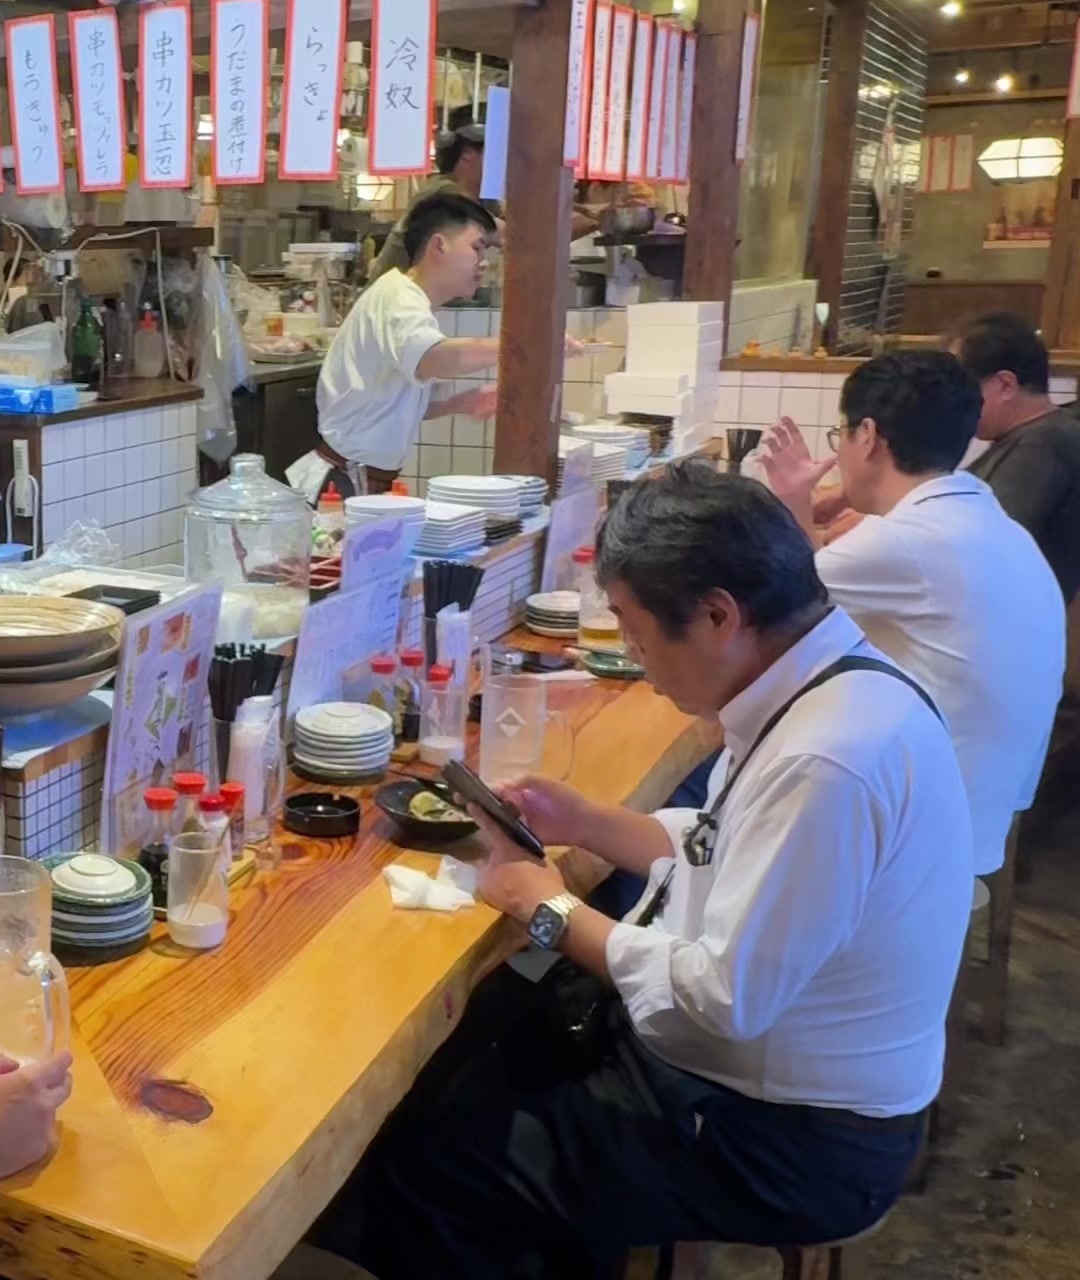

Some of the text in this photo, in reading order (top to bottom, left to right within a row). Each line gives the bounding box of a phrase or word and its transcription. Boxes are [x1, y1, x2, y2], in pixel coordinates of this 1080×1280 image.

[303, 26, 329, 121] らっきょ
[384, 35, 421, 111] 冷奴
